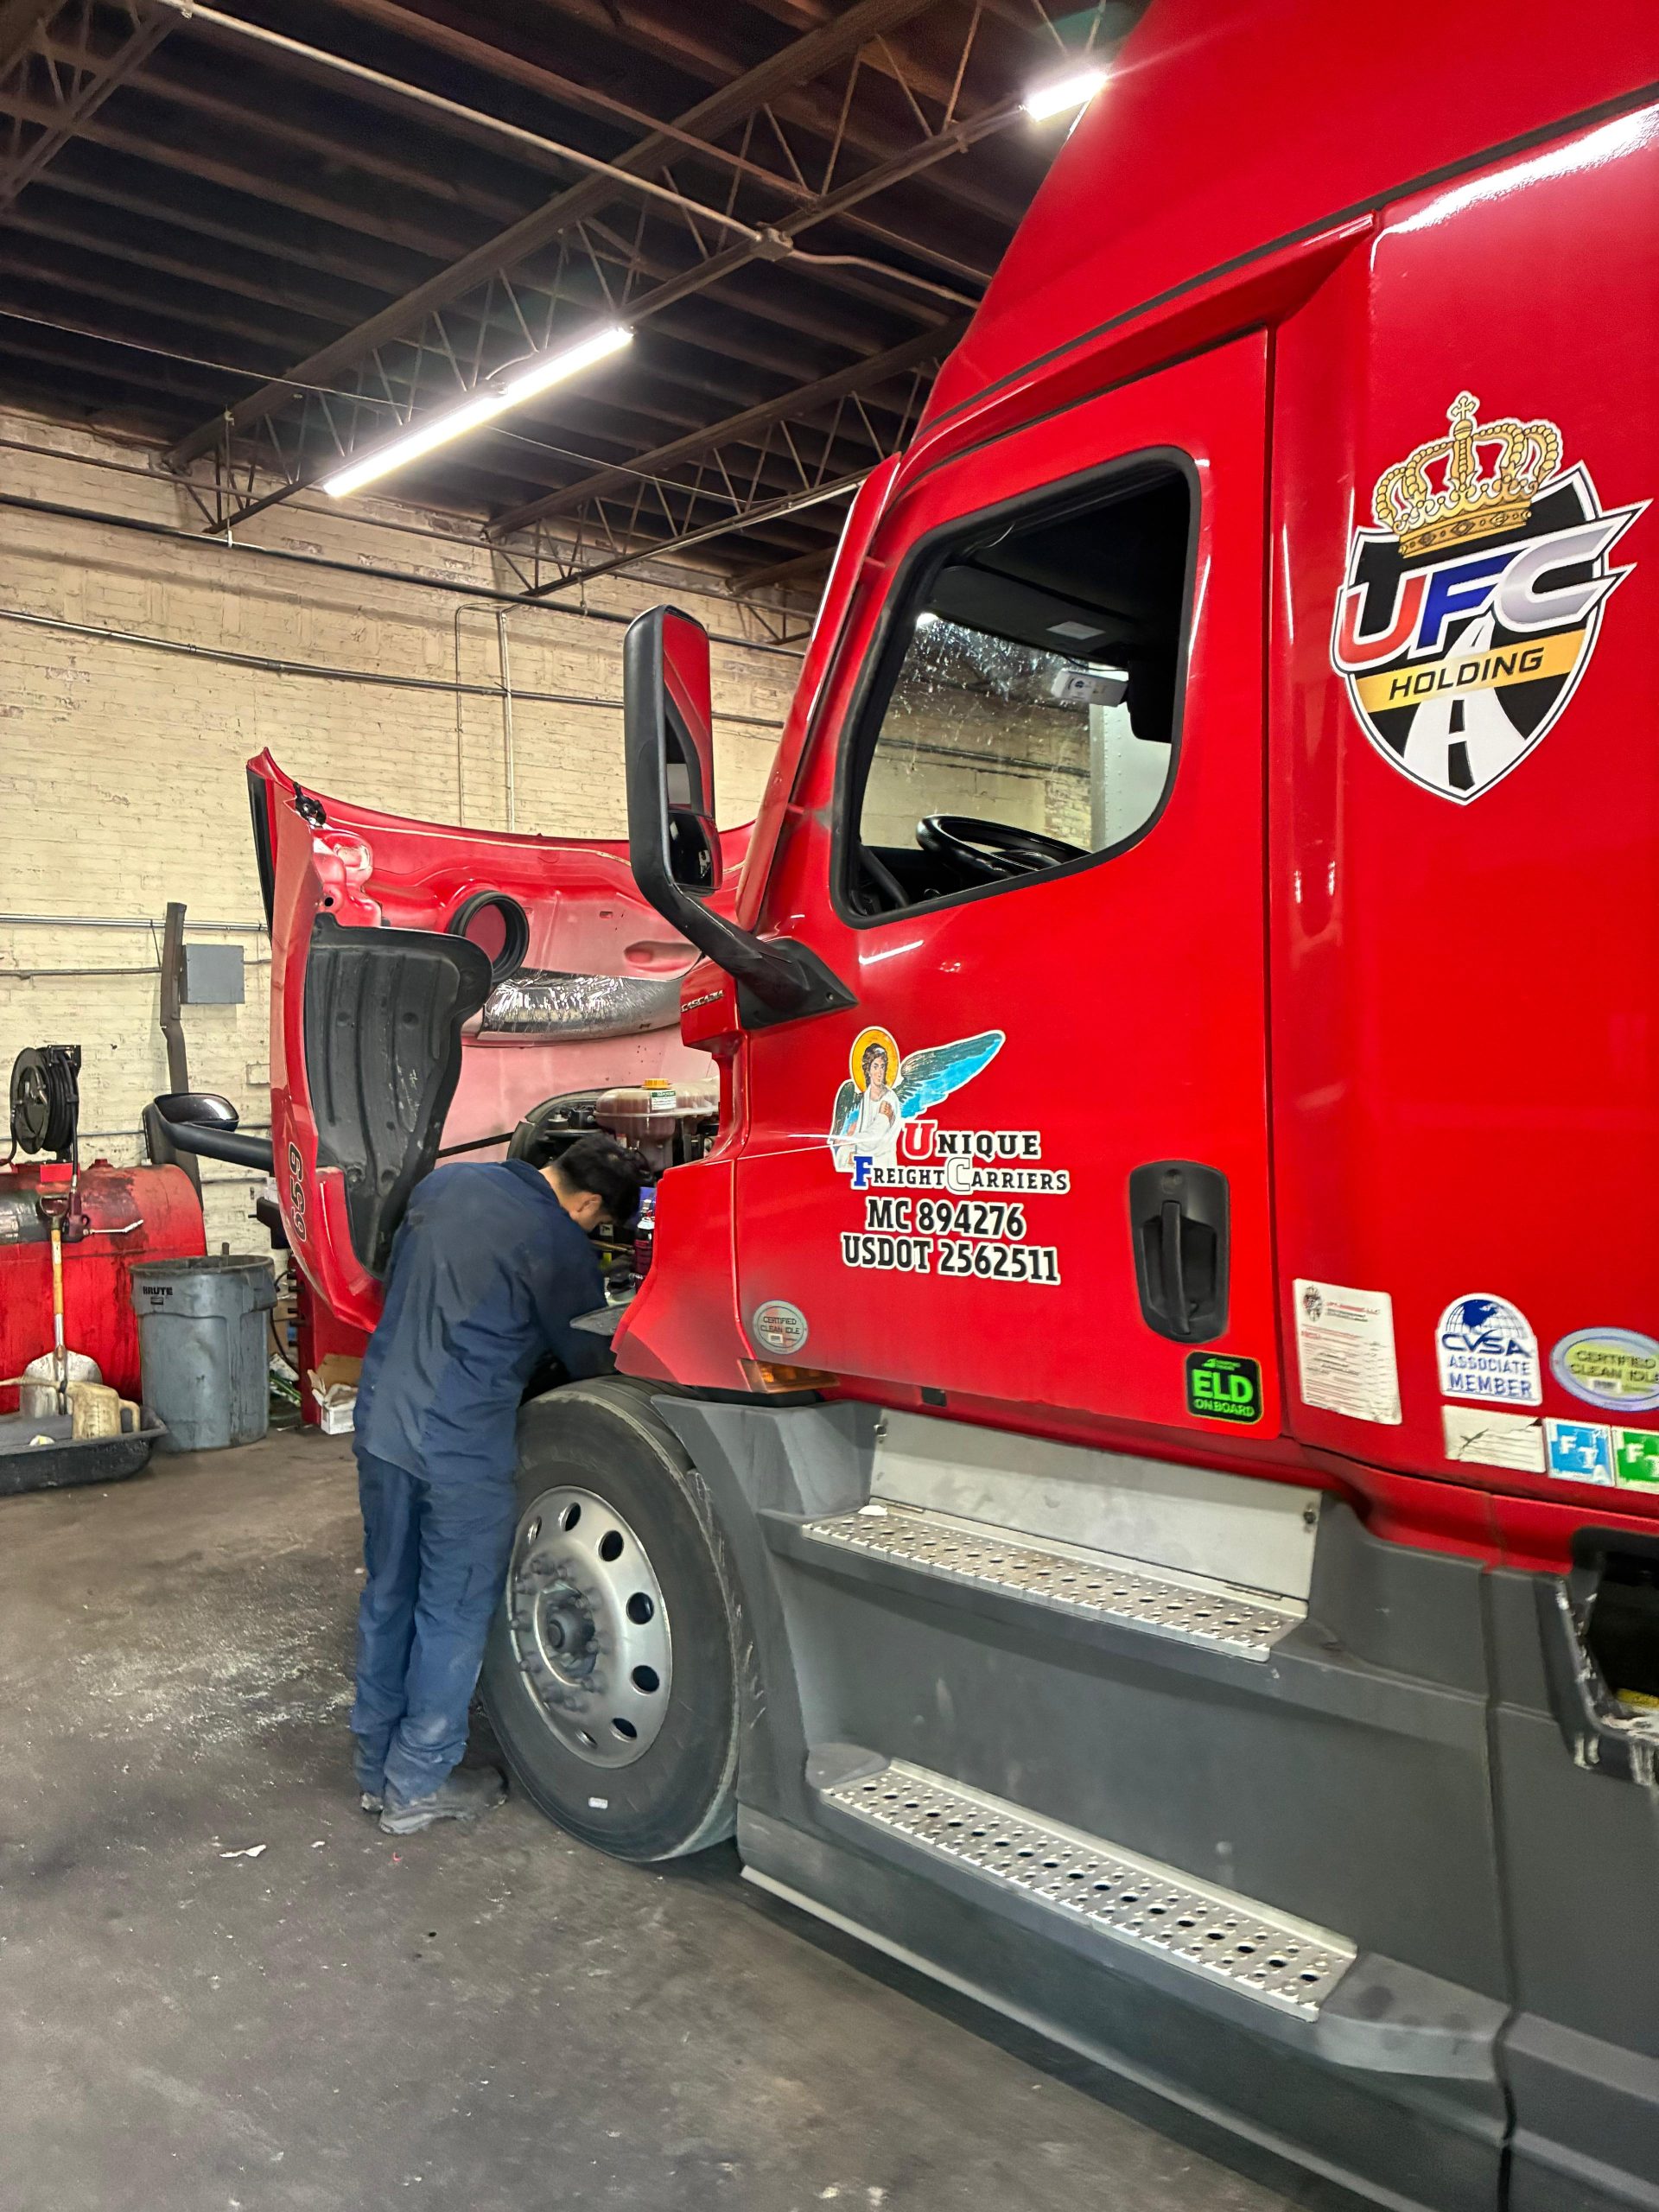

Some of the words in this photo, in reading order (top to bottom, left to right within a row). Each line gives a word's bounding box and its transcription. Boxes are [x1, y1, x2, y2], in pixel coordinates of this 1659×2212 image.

[1338, 518, 1624, 664] UFC
[1389, 647, 1545, 701] HOLDING
[903, 1122, 1039, 1159] UNIQUE
[289, 1141, 307, 1242] 659
[854, 1156, 945, 1187] FREIGHT
[947, 1157, 1068, 1192] CARRIERS
[868, 1198, 909, 1230] MC
[918, 1201, 1024, 1237] 894276
[842, 1235, 931, 1270] USDOT
[940, 1242, 1058, 1281] 2562511
[763, 1316, 797, 1325] CERTIFIED
[1442, 1329, 1533, 1358] CVSA
[1576, 1351, 1656, 1370] CERTIFIED
[1449, 1355, 1532, 1376] ASSOCIATE
[1571, 1363, 1623, 1379] CLEAN
[1192, 1369, 1254, 1404] ELD
[1449, 1372, 1534, 1398] MEMBER
